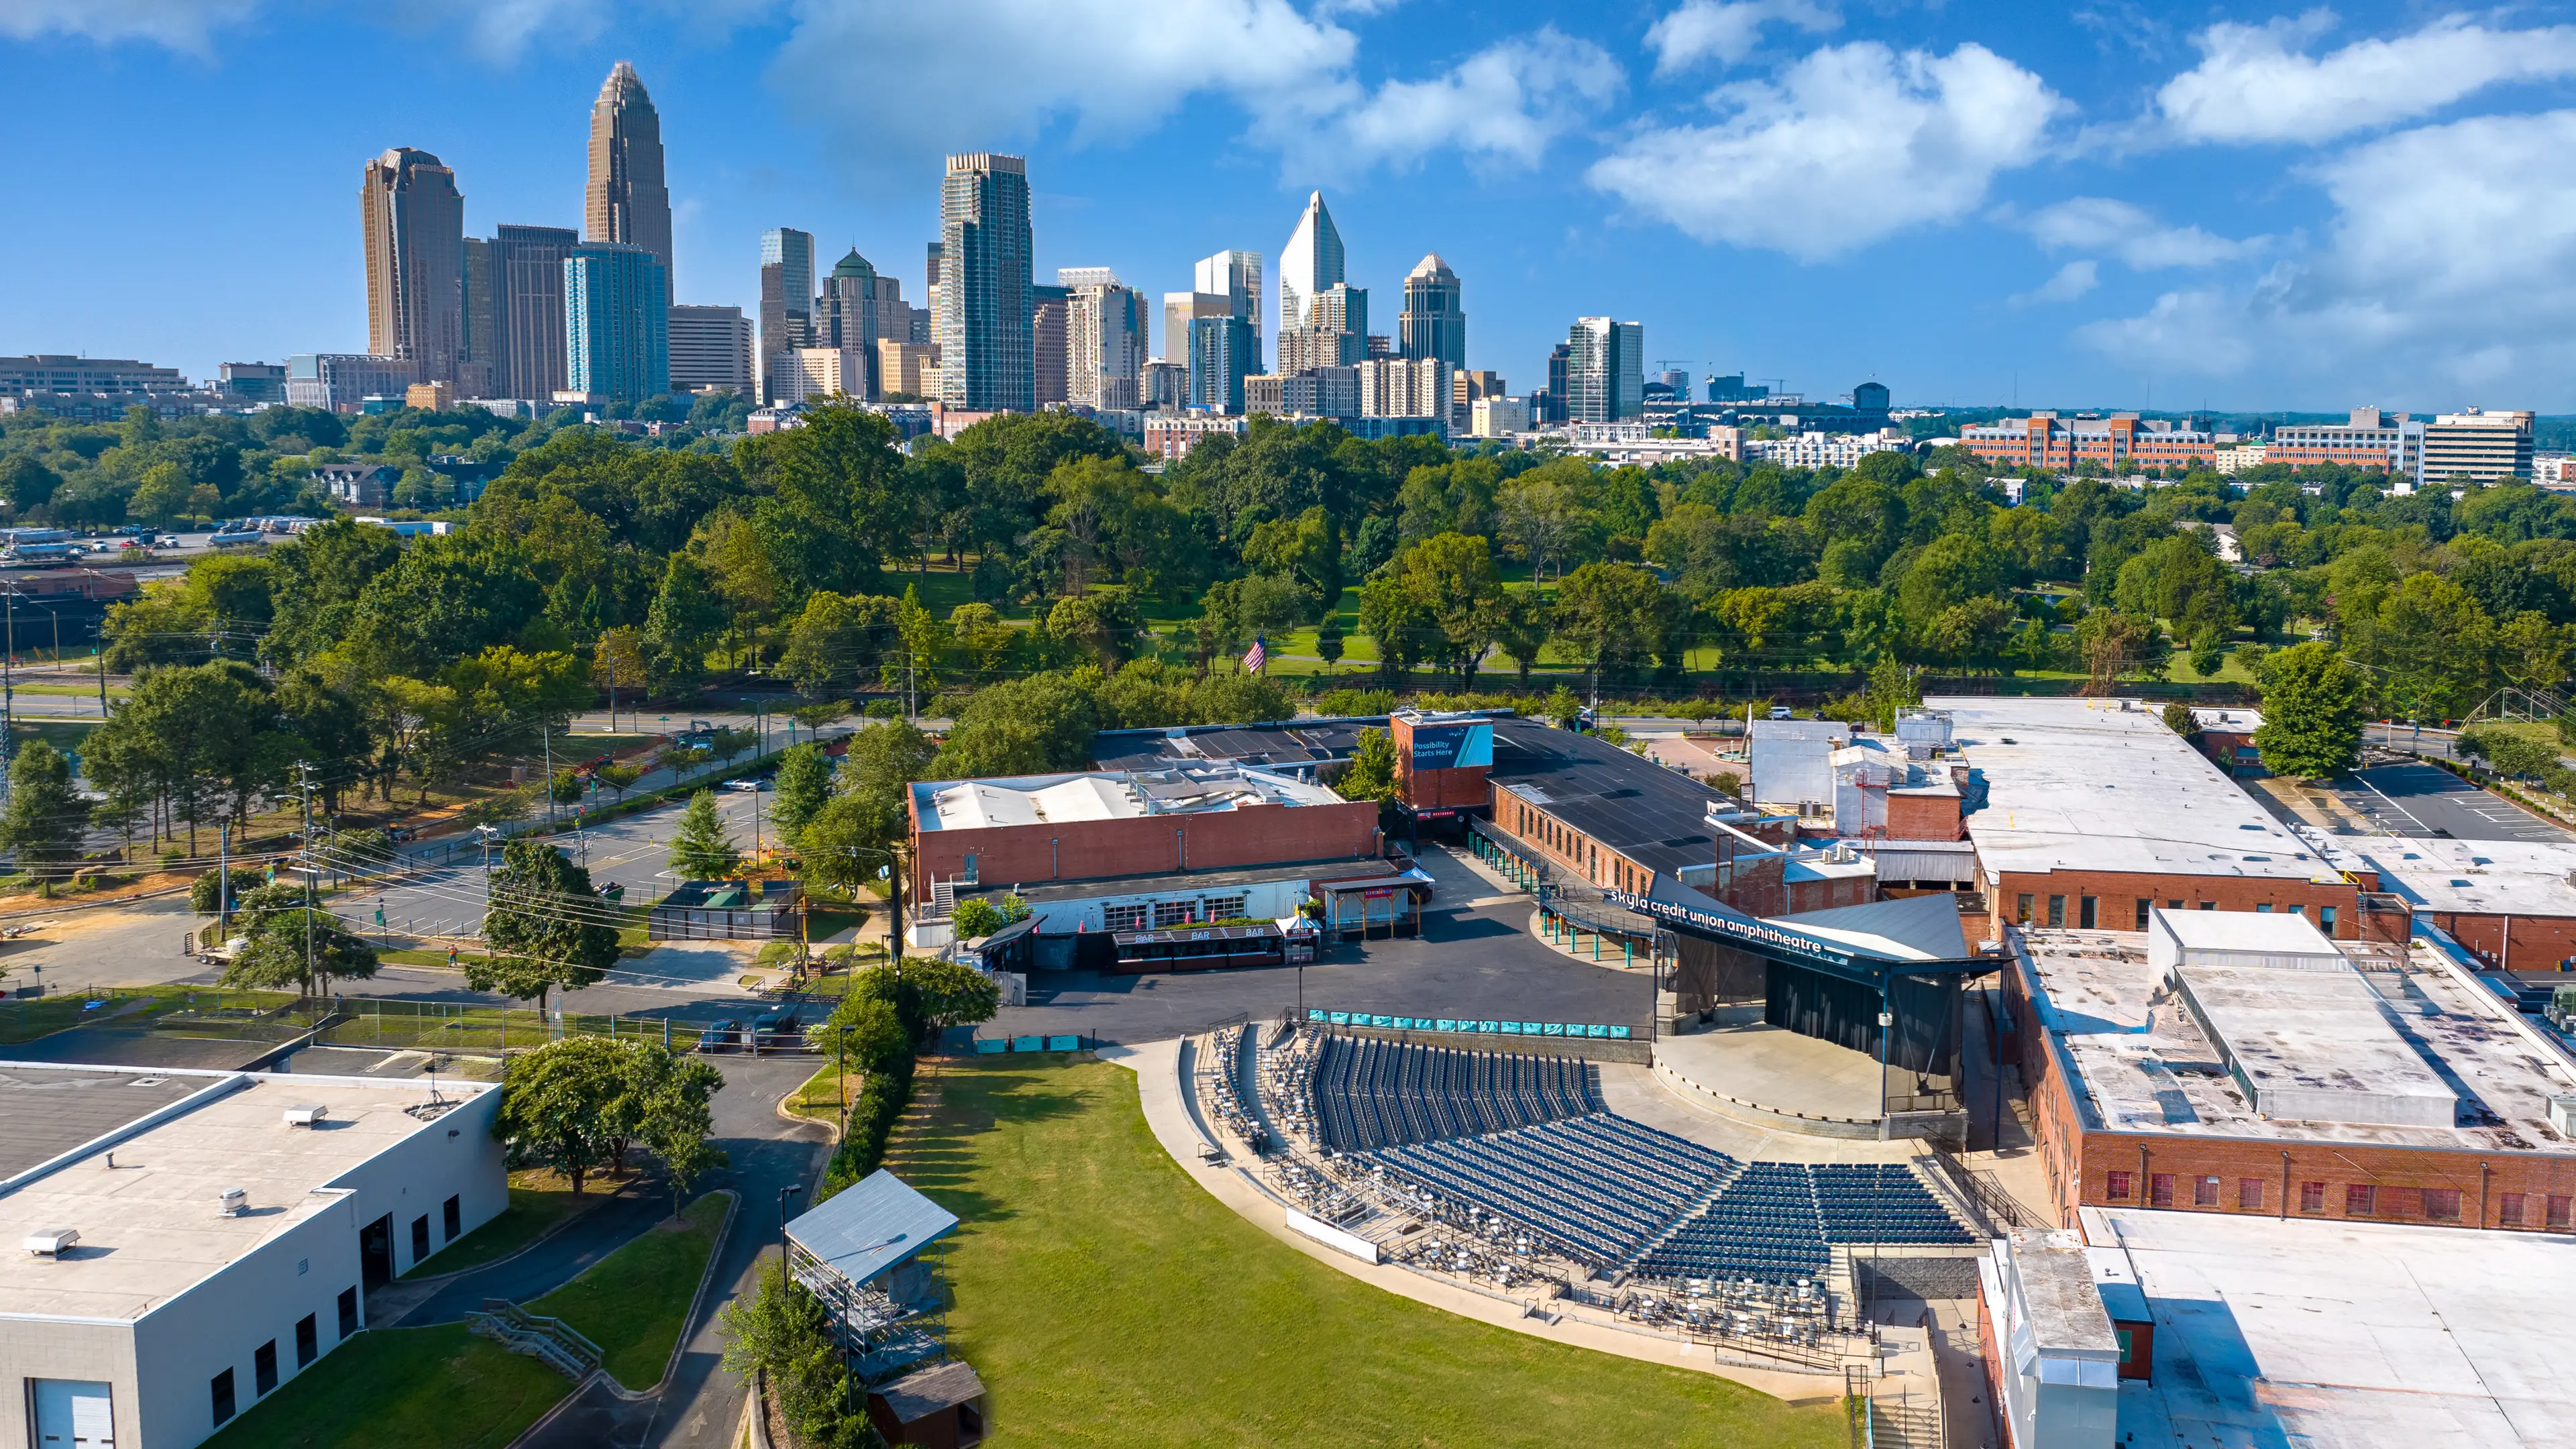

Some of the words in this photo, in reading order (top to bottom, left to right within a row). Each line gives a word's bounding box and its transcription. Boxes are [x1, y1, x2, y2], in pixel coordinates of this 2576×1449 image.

[1414, 741, 1449, 749] Possibility
[1611, 888, 1648, 910] skyla
[1651, 902, 1686, 918] credit
[1690, 913, 1725, 928] union
[1727, 921, 1821, 953] amphitheatre
[1191, 931, 1210, 940] BAR
[1246, 928, 1264, 936] BAR
[1135, 934, 1154, 943] BAR
